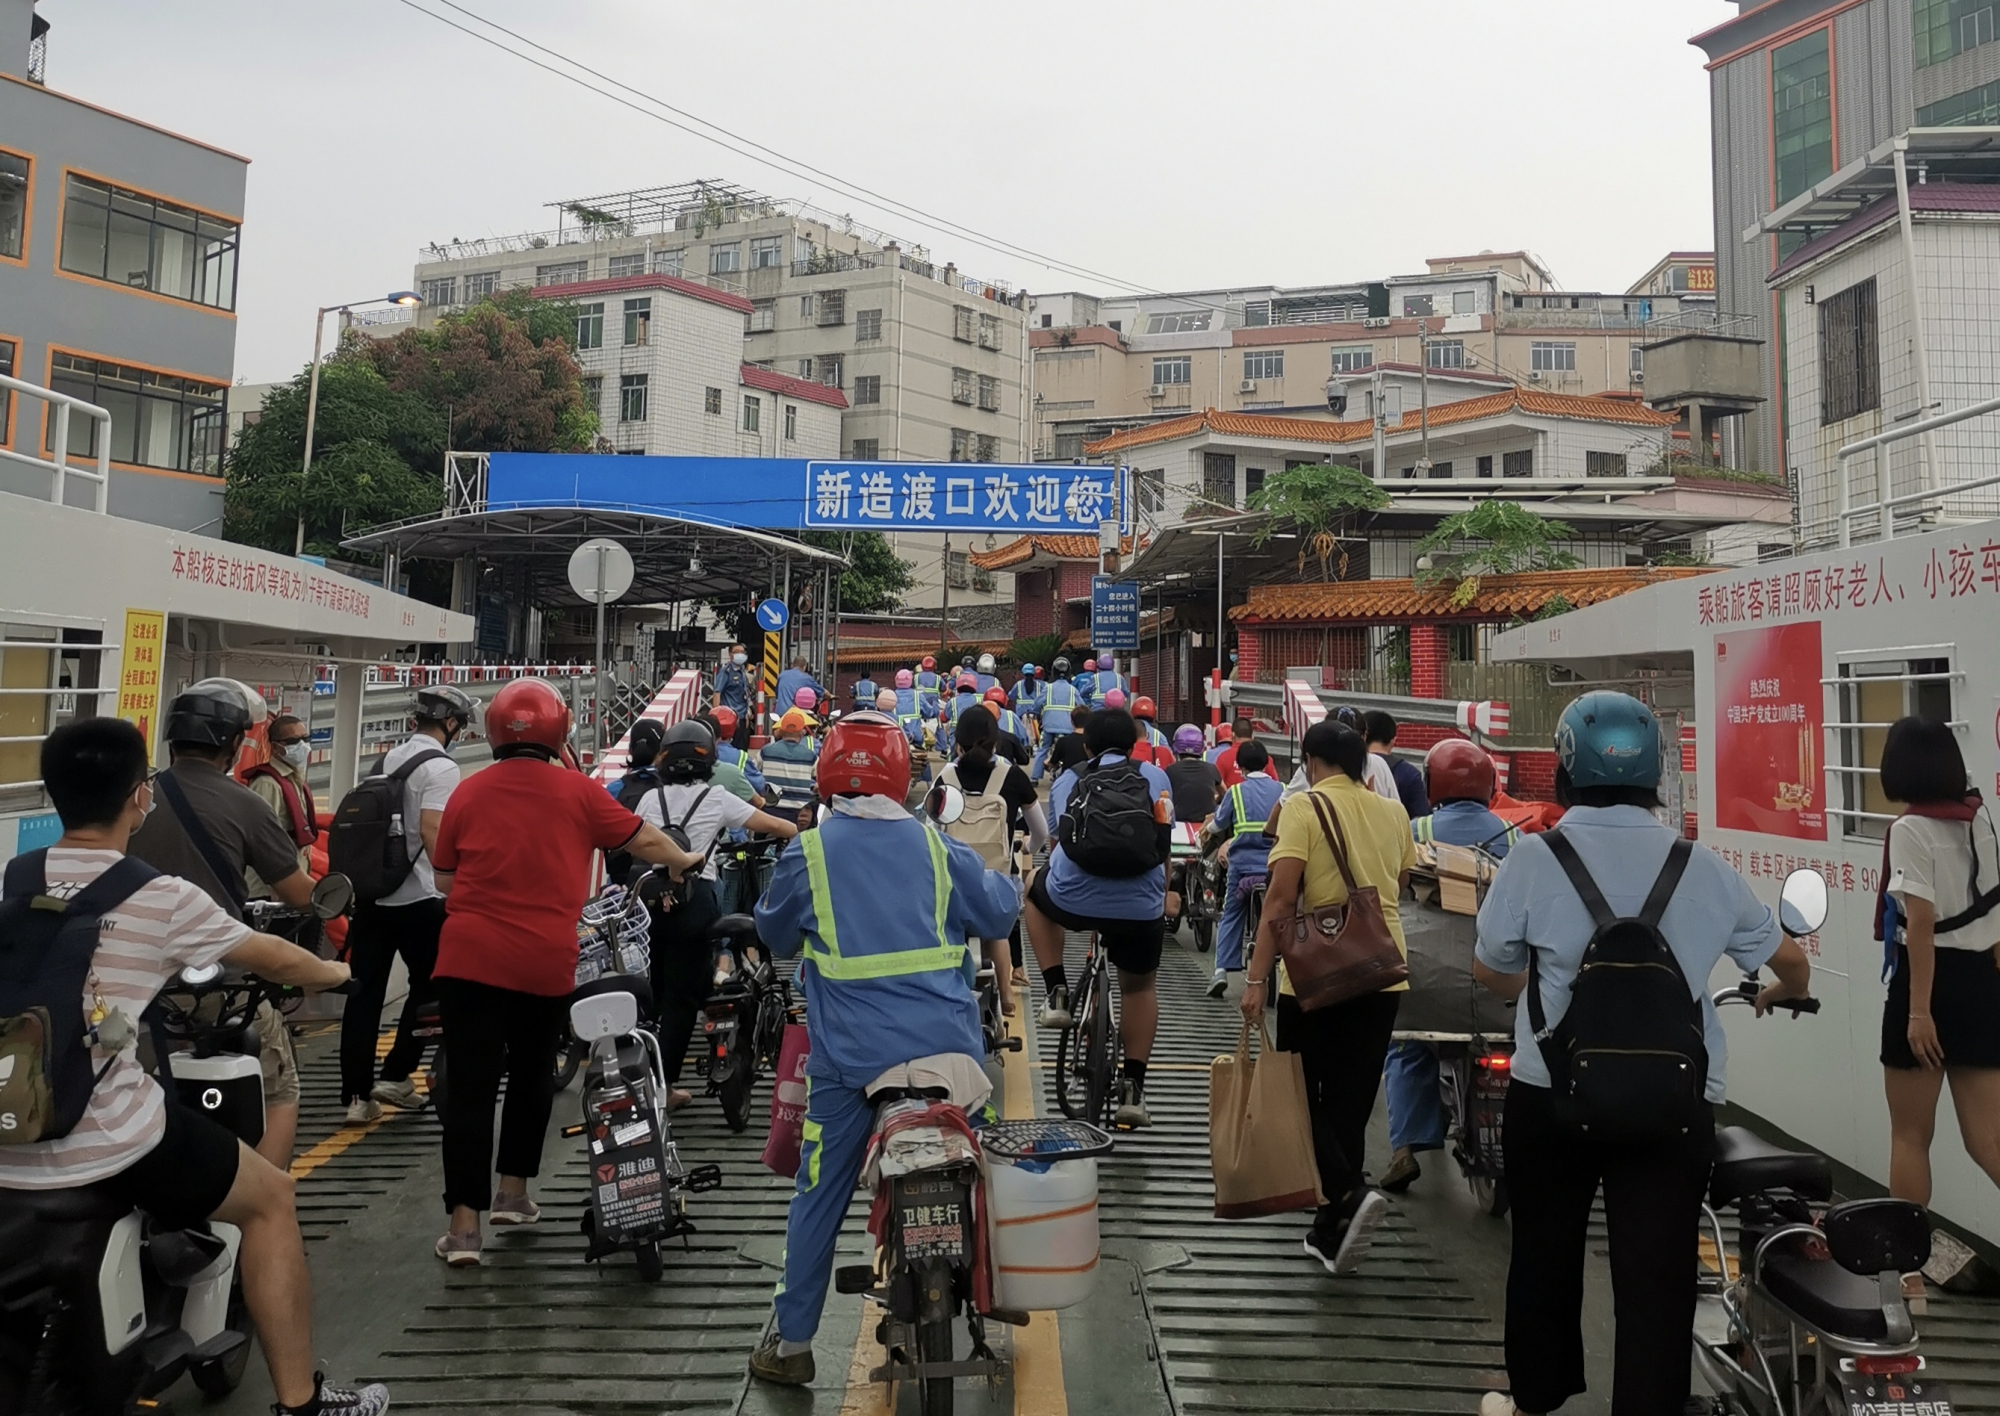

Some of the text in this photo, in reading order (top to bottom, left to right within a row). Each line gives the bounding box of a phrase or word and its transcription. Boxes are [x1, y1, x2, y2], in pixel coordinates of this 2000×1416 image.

[1750, 678, 1780, 698] 热烈庆祝
[1727, 704, 1806, 724] 中国共产党成立100周年
[618, 1156, 657, 1178] 雅迪
[902, 1203, 960, 1227] 卫健车行
